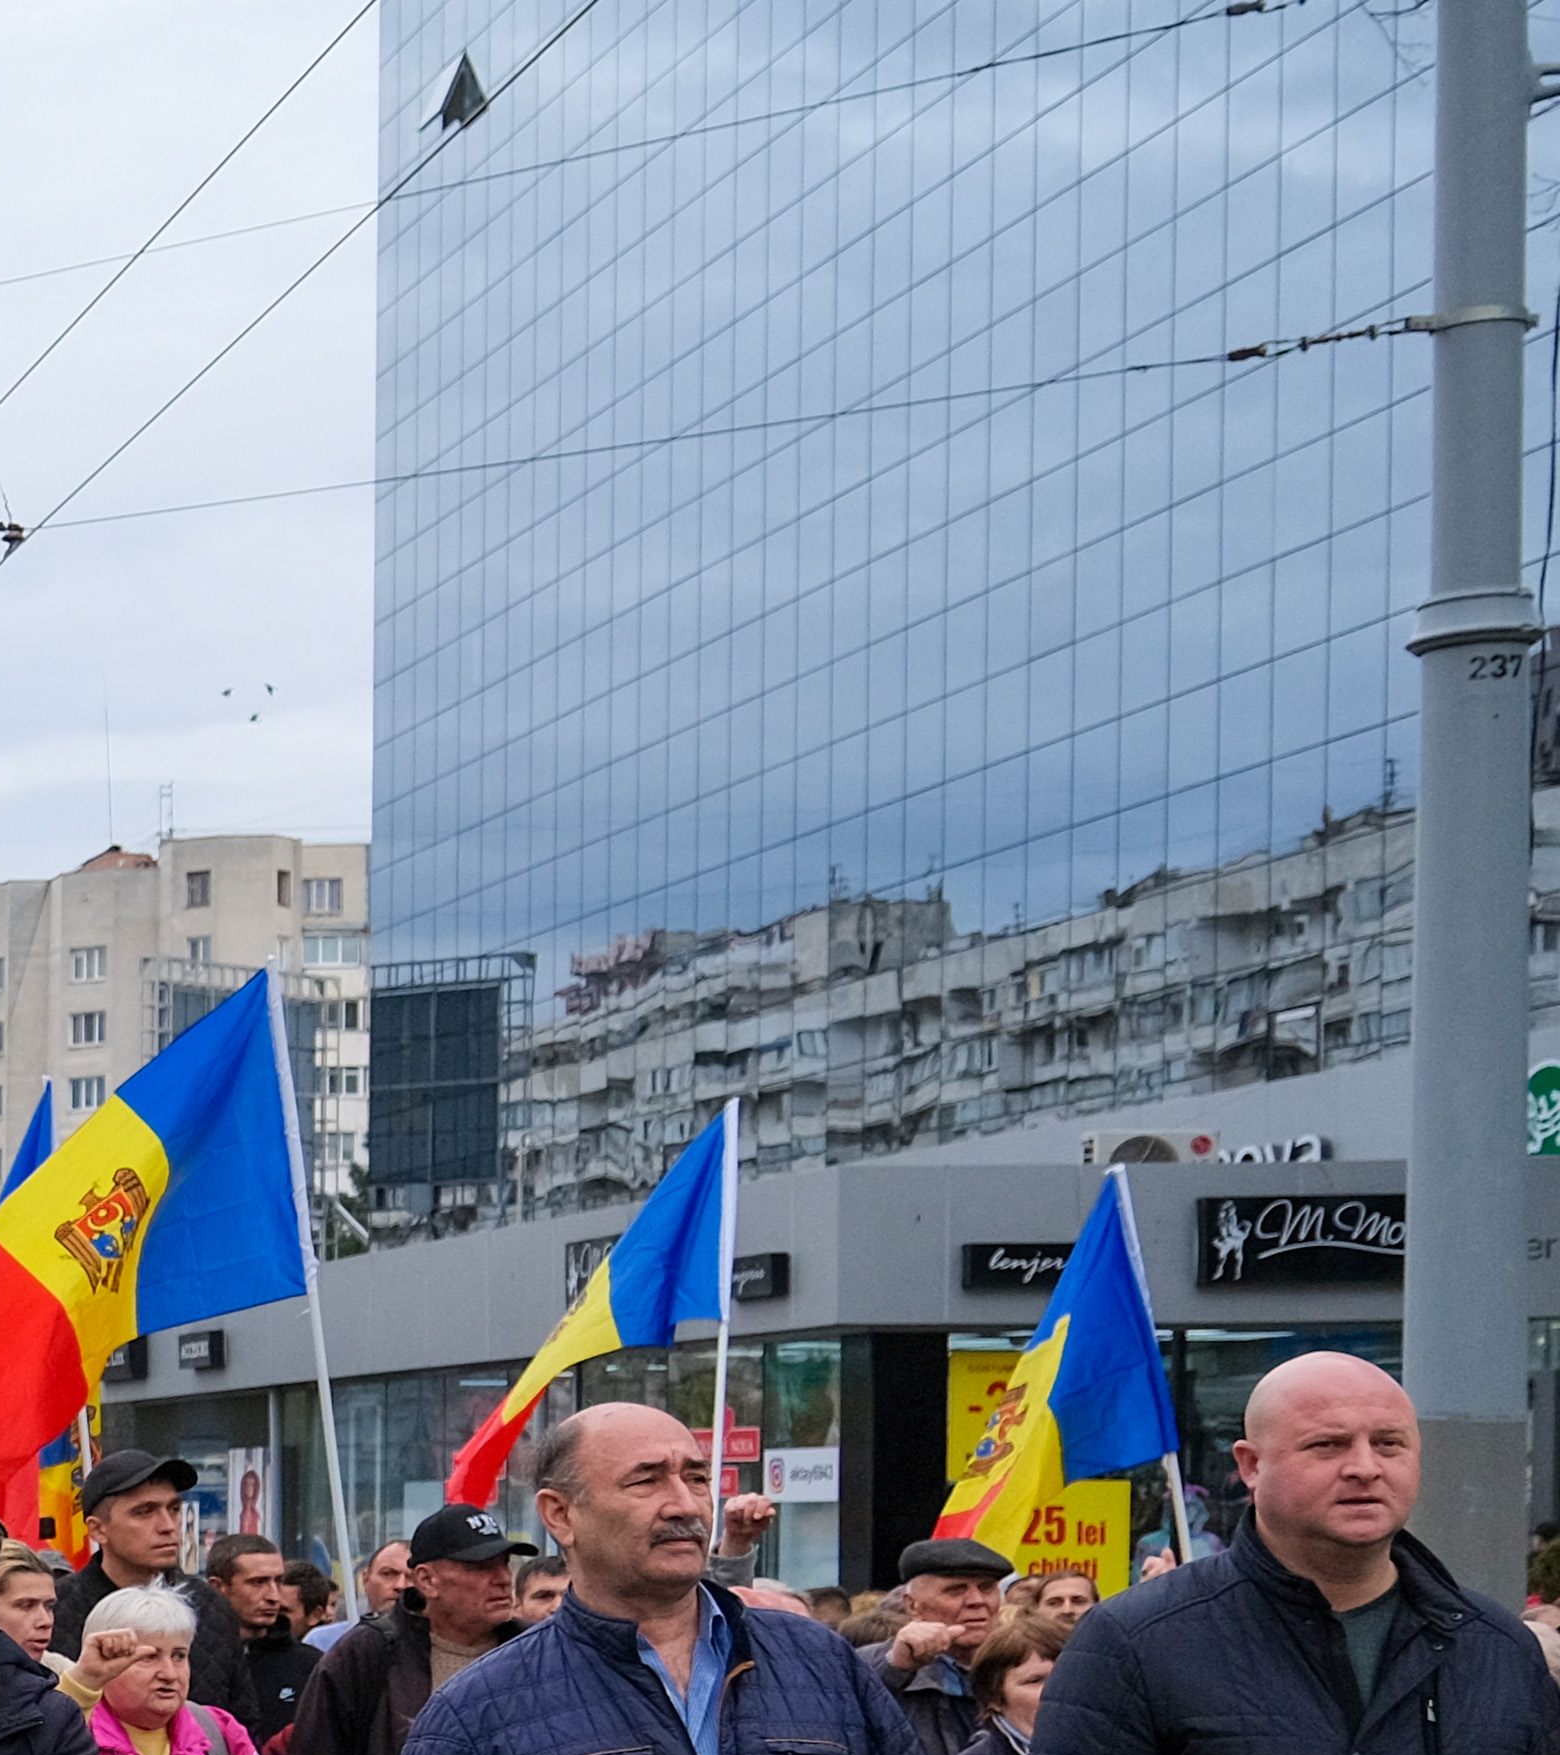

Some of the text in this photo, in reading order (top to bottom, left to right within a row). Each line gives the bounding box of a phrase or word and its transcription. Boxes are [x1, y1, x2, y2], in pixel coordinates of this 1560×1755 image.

[1469, 653, 1524, 679] 237
[988, 1247, 1067, 1284] lenjer
[1077, 1521, 1106, 1546] lei
